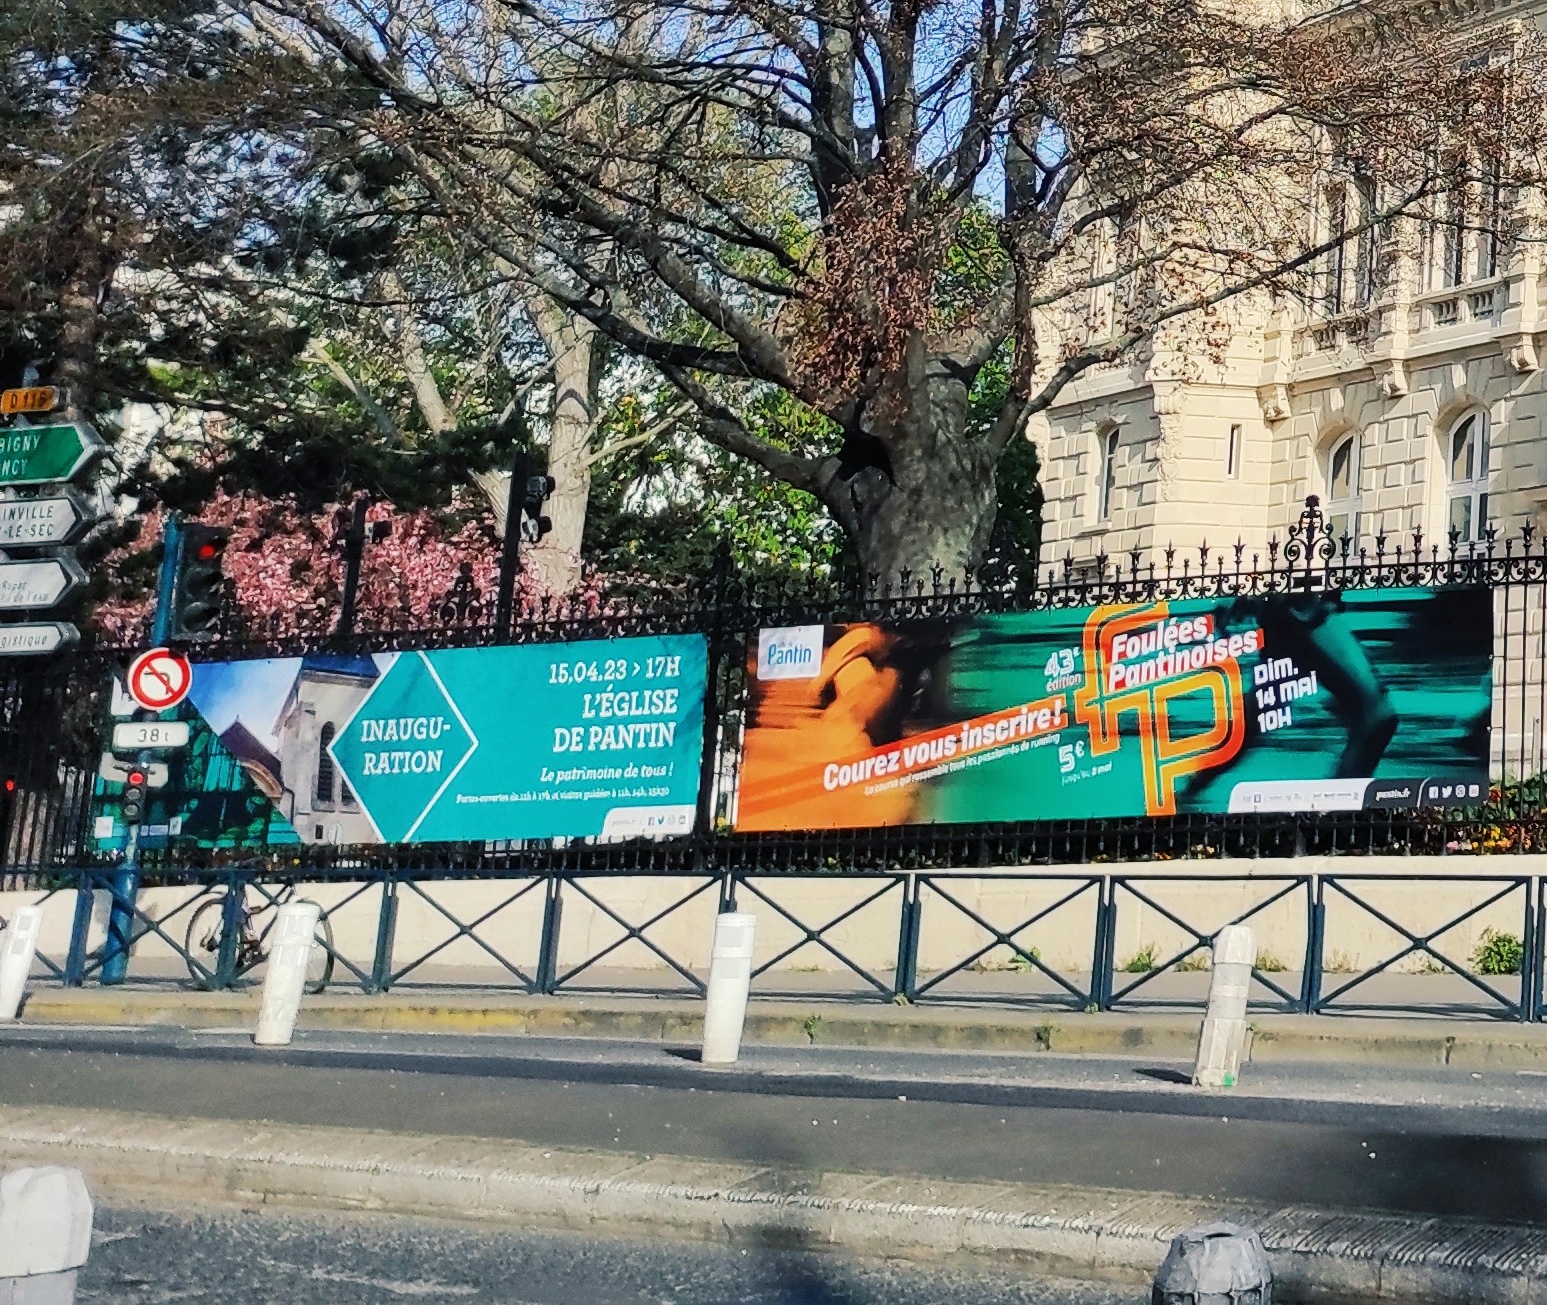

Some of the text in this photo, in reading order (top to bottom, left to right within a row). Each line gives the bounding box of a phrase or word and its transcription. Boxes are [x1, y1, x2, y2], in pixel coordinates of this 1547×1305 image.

[0, 524, 54, 538] -LE-SEC
[1, 635, 47, 648] gistique
[1112, 616, 1208, 663] Foulées
[767, 643, 811, 665] Pantin
[1109, 630, 1259, 693] Pantinoises
[549, 659, 627, 684] 15.04.23
[646, 656, 681, 678] 17H
[1046, 673, 1082, 692] édition
[582, 684, 678, 718] L'ÉGLISE
[1256, 686, 1276, 709] 14
[361, 717, 451, 742] INAUGU-
[1258, 706, 1292, 732] 10H
[138, 728, 159, 742] 38
[553, 722, 676, 752] DE PANTIN
[823, 750, 900, 791] Courez
[903, 735, 957, 769] vous
[960, 707, 1051, 751] inscrire
[363, 750, 443, 775] RATION
[540, 767, 555, 783] Le
[556, 765, 622, 785] patrimoine
[624, 761, 638, 778] de
[641, 765, 666, 777] tous
